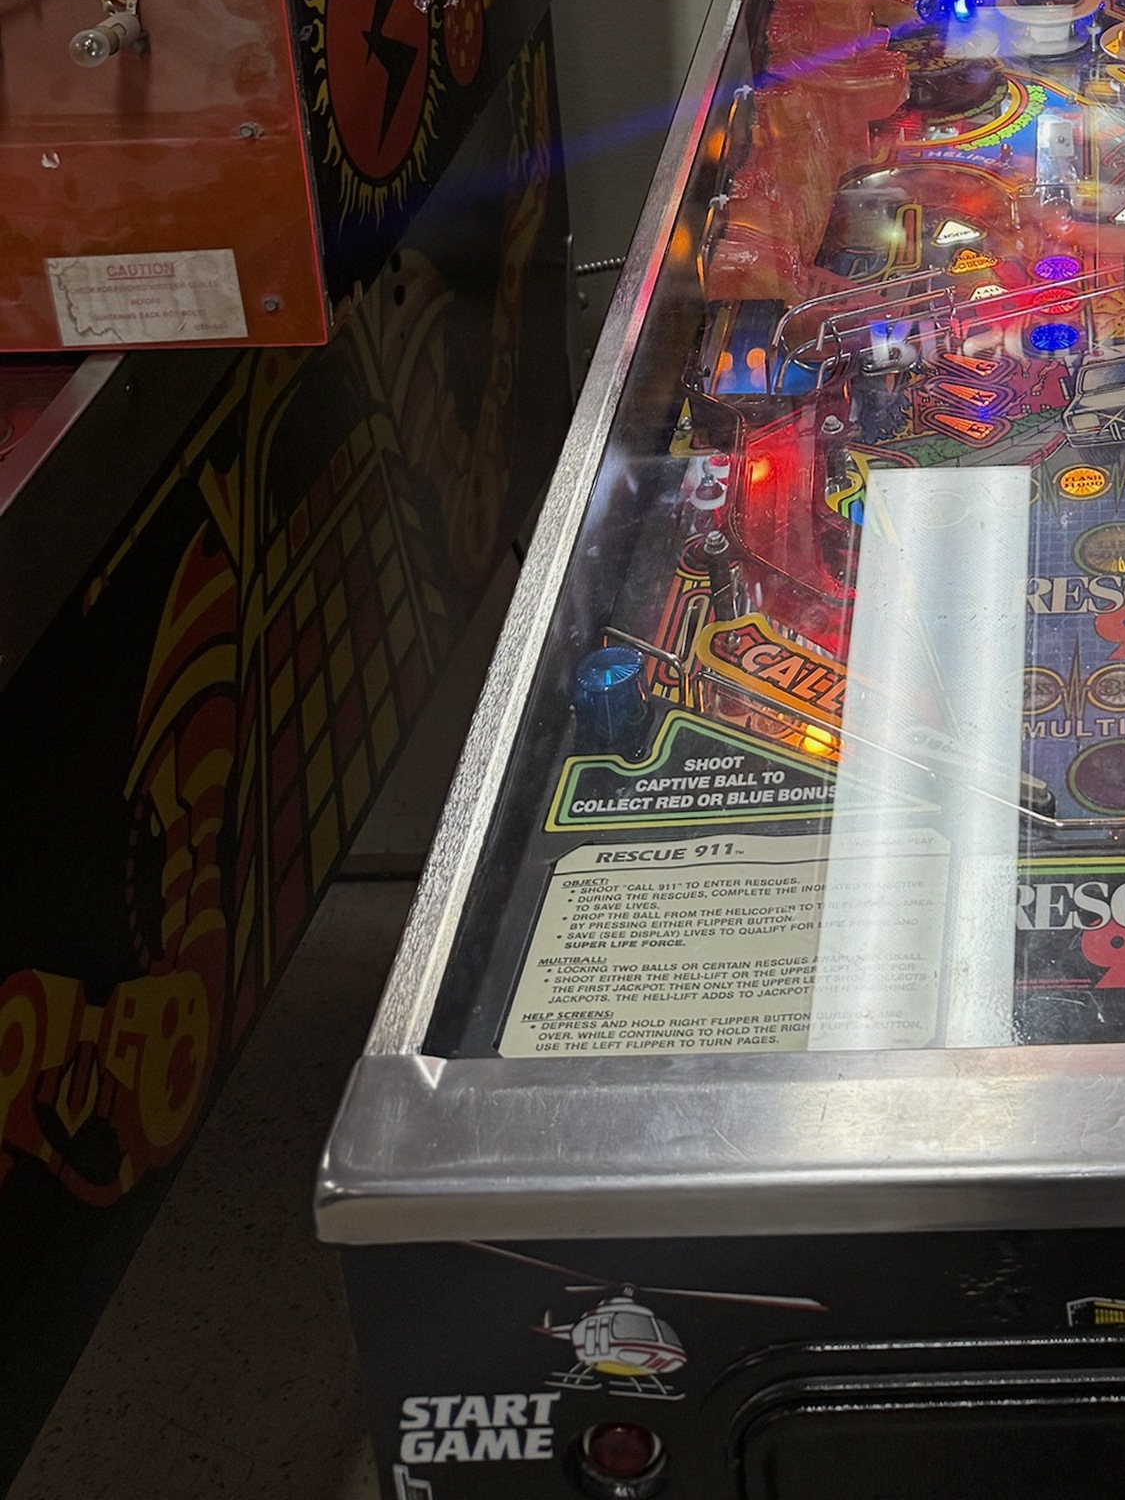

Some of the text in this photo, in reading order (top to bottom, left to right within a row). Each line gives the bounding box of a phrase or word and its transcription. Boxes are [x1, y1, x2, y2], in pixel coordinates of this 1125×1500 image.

[107, 263, 176, 277] CAUTION
[684, 756, 744, 772] SHOOT
[635, 771, 785, 792] CAPTIVE BALL TO
[571, 785, 837, 813] COLLECT RED OR BLUE BONUS
[595, 842, 734, 864] RESCUE 911
[562, 878, 609, 889] OBJECT:
[580, 885, 619, 894] SHOOT
[685, 881, 699, 889] TO
[703, 879, 740, 888] ENTER
[745, 877, 800, 887] RESCUES.
[572, 913, 605, 922] DROP
[607, 912, 628, 920] THE
[632, 911, 660, 920] BALL
[664, 910, 697, 919] FROM
[700, 908, 722, 917] THE
[725, 905, 795, 916] HELICOPTER
[799, 902, 813, 911] TO
[575, 902, 660, 912] TO SAVE LIVES.
[567, 931, 597, 940] SAVE
[600, 930, 626, 939] (SEE
[630, 929, 680, 939] DISPLAY)
[684, 928, 716, 937] LIVES
[720, 927, 734, 936] TO
[738, 925, 786, 936] QUALIFY
[790, 922, 814, 931] FOR
[569, 915, 796, 931] BY PRESSING EITHER FLIPPER BUTTON.
[538, 956, 607, 966] MULTIBALL:
[557, 956, 808, 974] LOCKING TWO BALLS OR CERTAIN RESCUES
[554, 975, 596, 984] SHOOT
[599, 974, 642, 983] EITHER
[646, 973, 669, 982] THE
[673, 971, 728, 981] HELI-LIFT
[732, 970, 749, 979] OR
[754, 969, 776, 978] THE
[548, 994, 611, 1004] JACKPOTS.
[615, 993, 639, 1002] THE
[643, 992, 698, 1001] HELI-LIFT
[701, 991, 734, 1000] ADDS
[738, 990, 753, 999] TO
[757, 986, 810, 998] JACKPOT
[522, 1010, 614, 1022] HELP SCREENS:
[541, 1021, 597, 1030] DEPRESS
[601, 1020, 627, 1029] AND
[631, 1019, 665, 1028] HOLD
[669, 1017, 708, 1027] RIGHT
[711, 1015, 759, 1026] FLIPPER
[763, 1012, 812, 1023] BUTTON
[535, 1035, 779, 1052] USE THE LEFT FLIPPER TO TURN PAGES.
[400, 1391, 561, 1431] START
[400, 1428, 554, 1464] GAME
